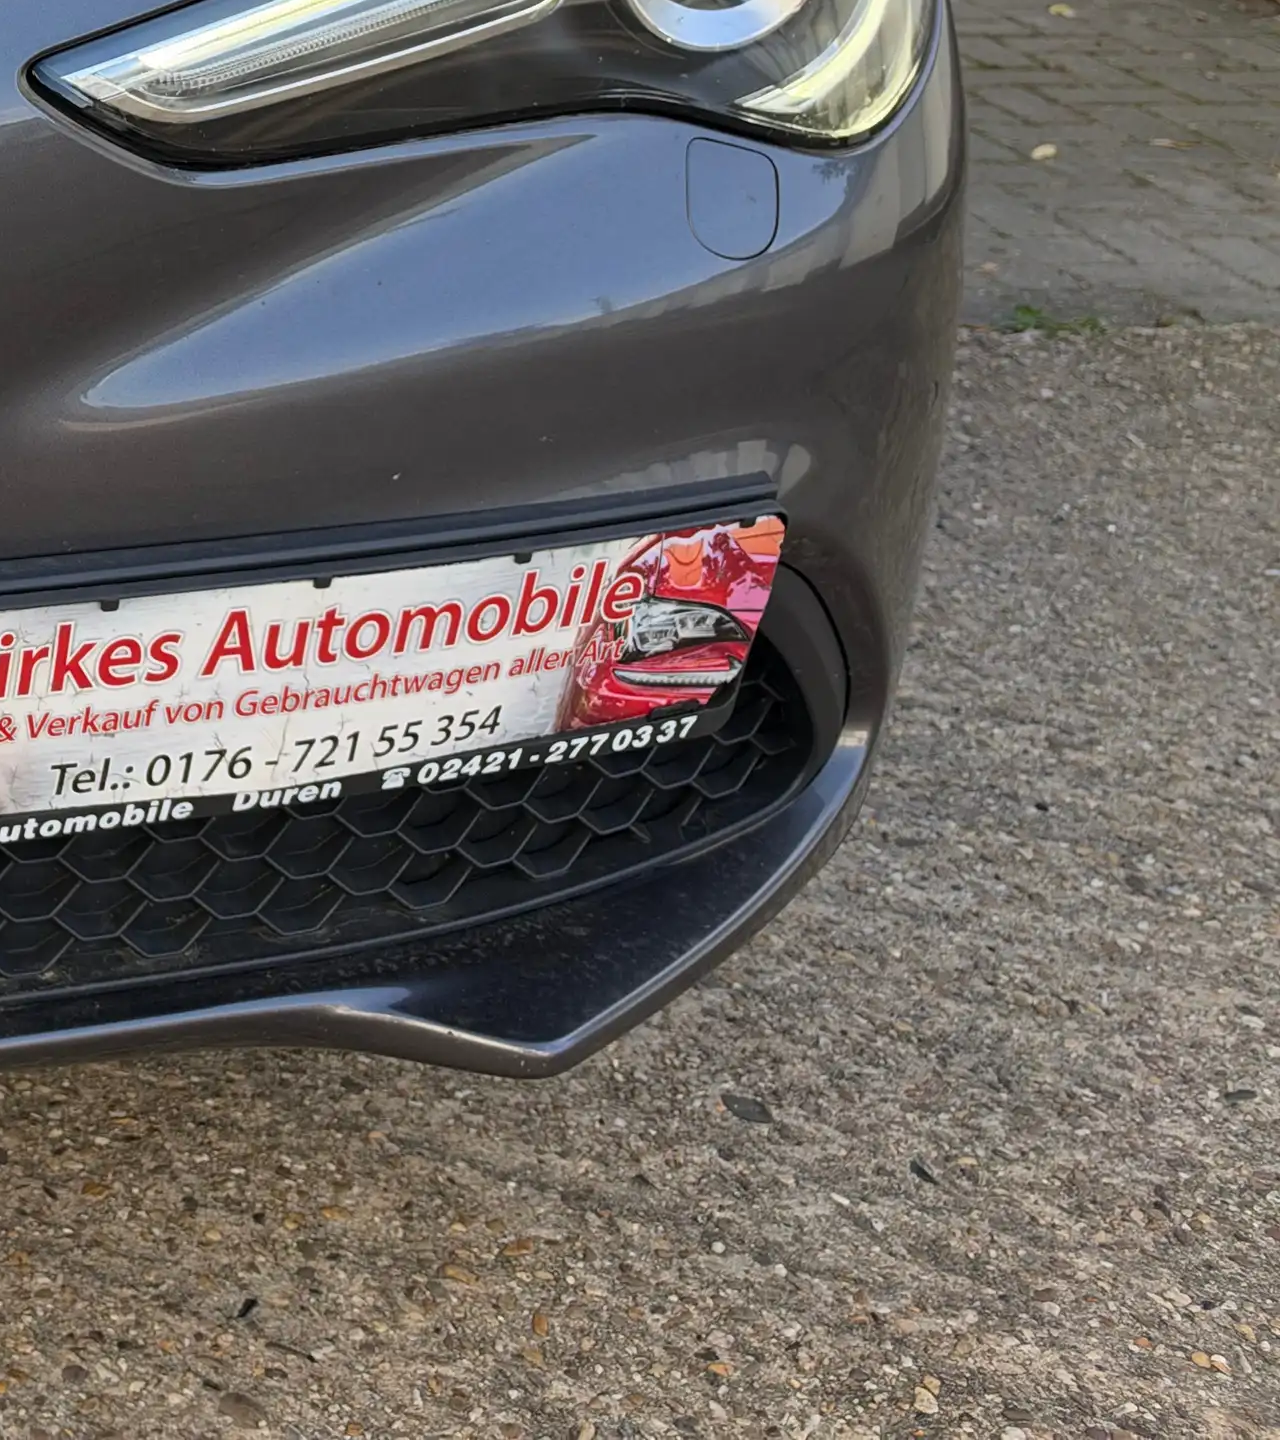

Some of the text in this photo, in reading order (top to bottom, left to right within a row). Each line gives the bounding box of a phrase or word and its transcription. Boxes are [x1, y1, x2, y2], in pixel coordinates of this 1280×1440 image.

[201, 561, 645, 678] Automobile
[26, 697, 160, 740] Verkauf
[165, 693, 225, 725] von
[234, 663, 502, 717] Gebrauchtwagen
[507, 646, 574, 678] aller
[577, 636, 625, 667] Art
[50, 755, 135, 797] Tel.:
[146, 744, 253, 787] 0176
[430, 705, 503, 747] 354
[417, 747, 523, 785] 02421
